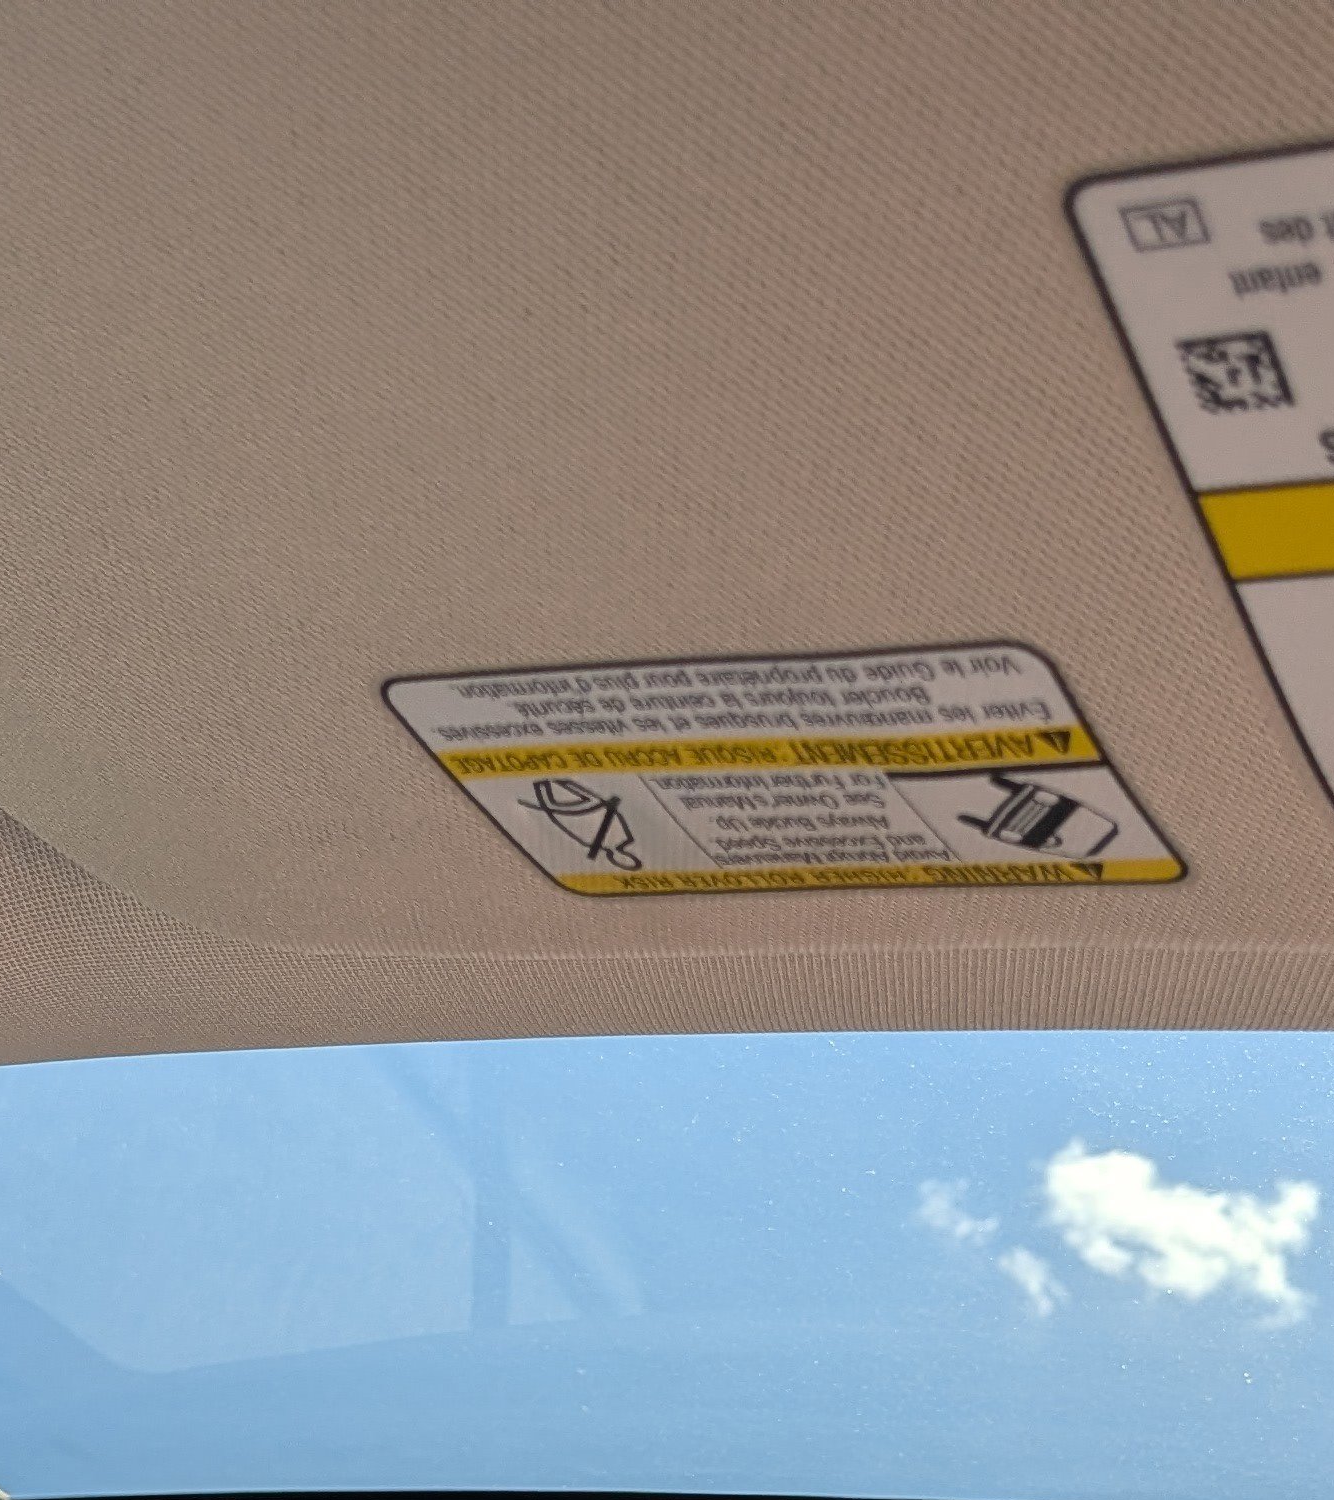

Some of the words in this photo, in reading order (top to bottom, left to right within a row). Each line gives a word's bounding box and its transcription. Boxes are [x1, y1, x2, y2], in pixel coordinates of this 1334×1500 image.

[1141, 205, 1189, 243] AL
[1227, 262, 1322, 299] enfant
[787, 734, 1034, 766] AVERTISSEMENT
[922, 864, 1073, 884] WARNING
